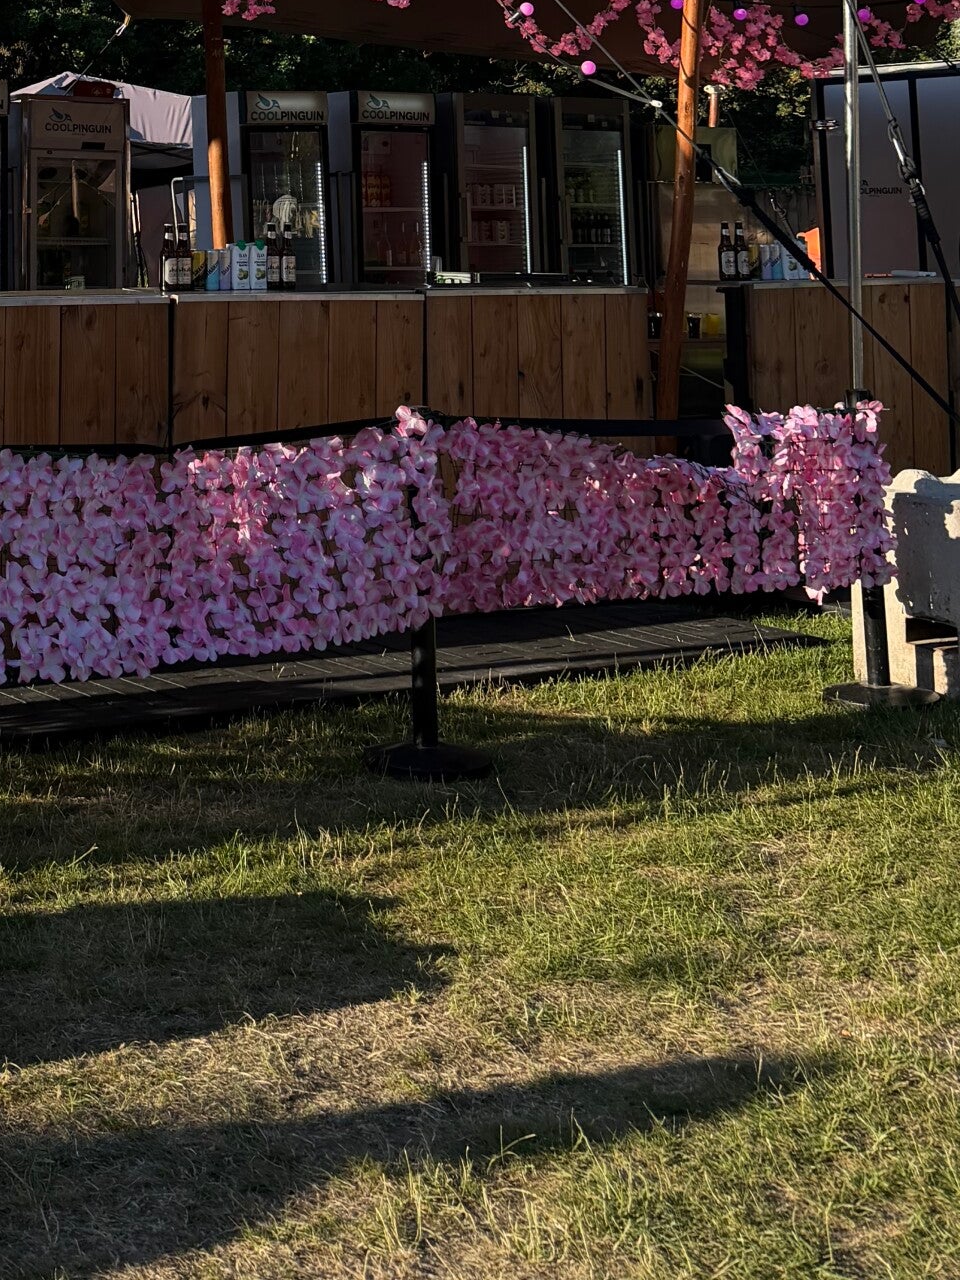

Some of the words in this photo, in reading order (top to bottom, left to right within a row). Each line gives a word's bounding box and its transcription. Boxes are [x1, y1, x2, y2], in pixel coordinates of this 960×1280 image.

[250, 111, 324, 121] COOLPINGUIN
[362, 110, 430, 121] COOLPINGUIN
[45, 123, 112, 134] COOLPINGUIN
